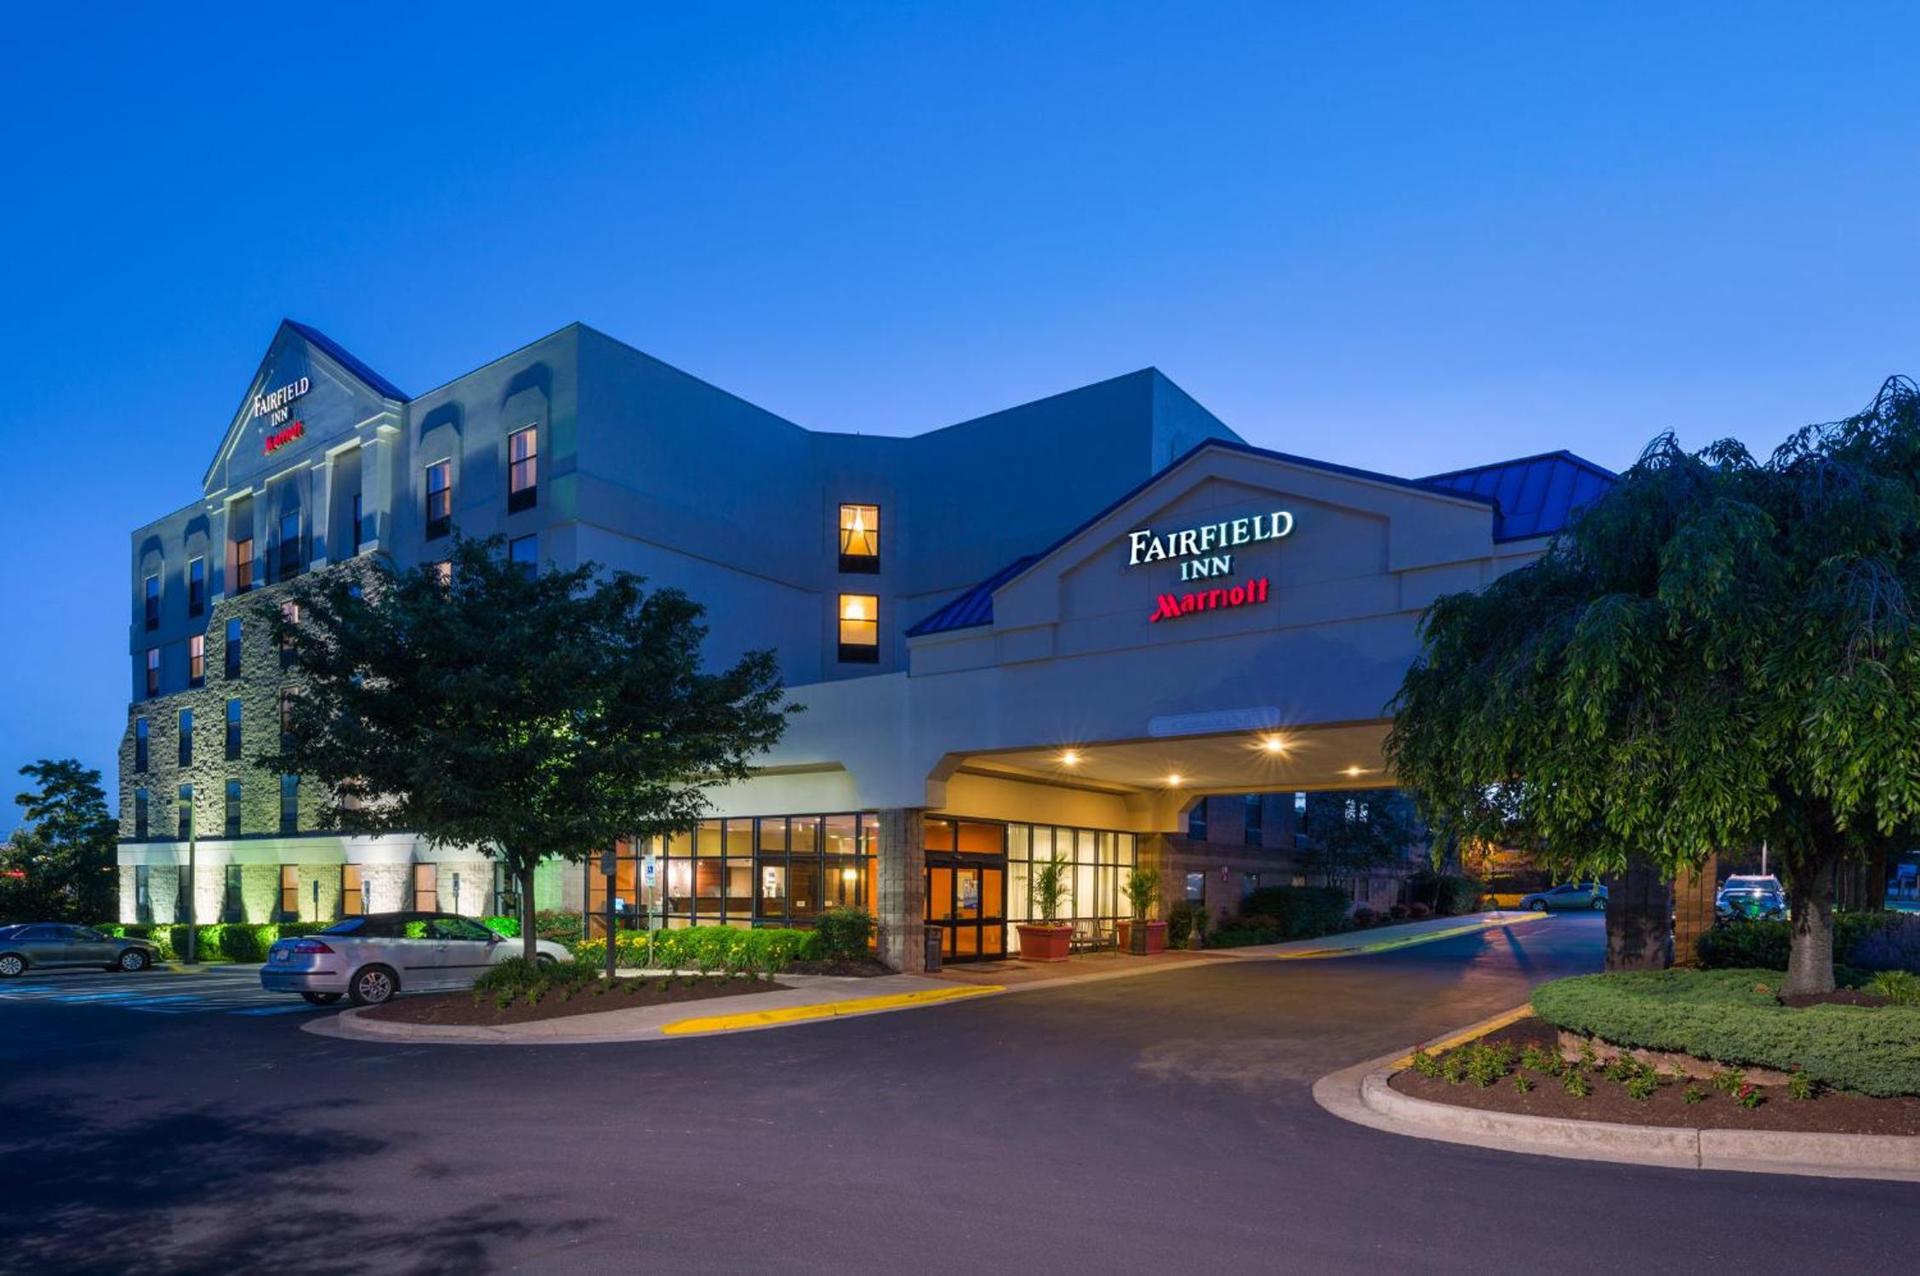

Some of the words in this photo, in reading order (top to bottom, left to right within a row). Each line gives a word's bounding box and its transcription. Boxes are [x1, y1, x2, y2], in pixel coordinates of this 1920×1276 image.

[254, 376, 309, 417] FAIRFIELD
[271, 406, 288, 427] INN
[1128, 511, 1294, 566] FAIRFIELD
[1180, 554, 1232, 581] INN
[1148, 576, 1270, 623] Marriott
